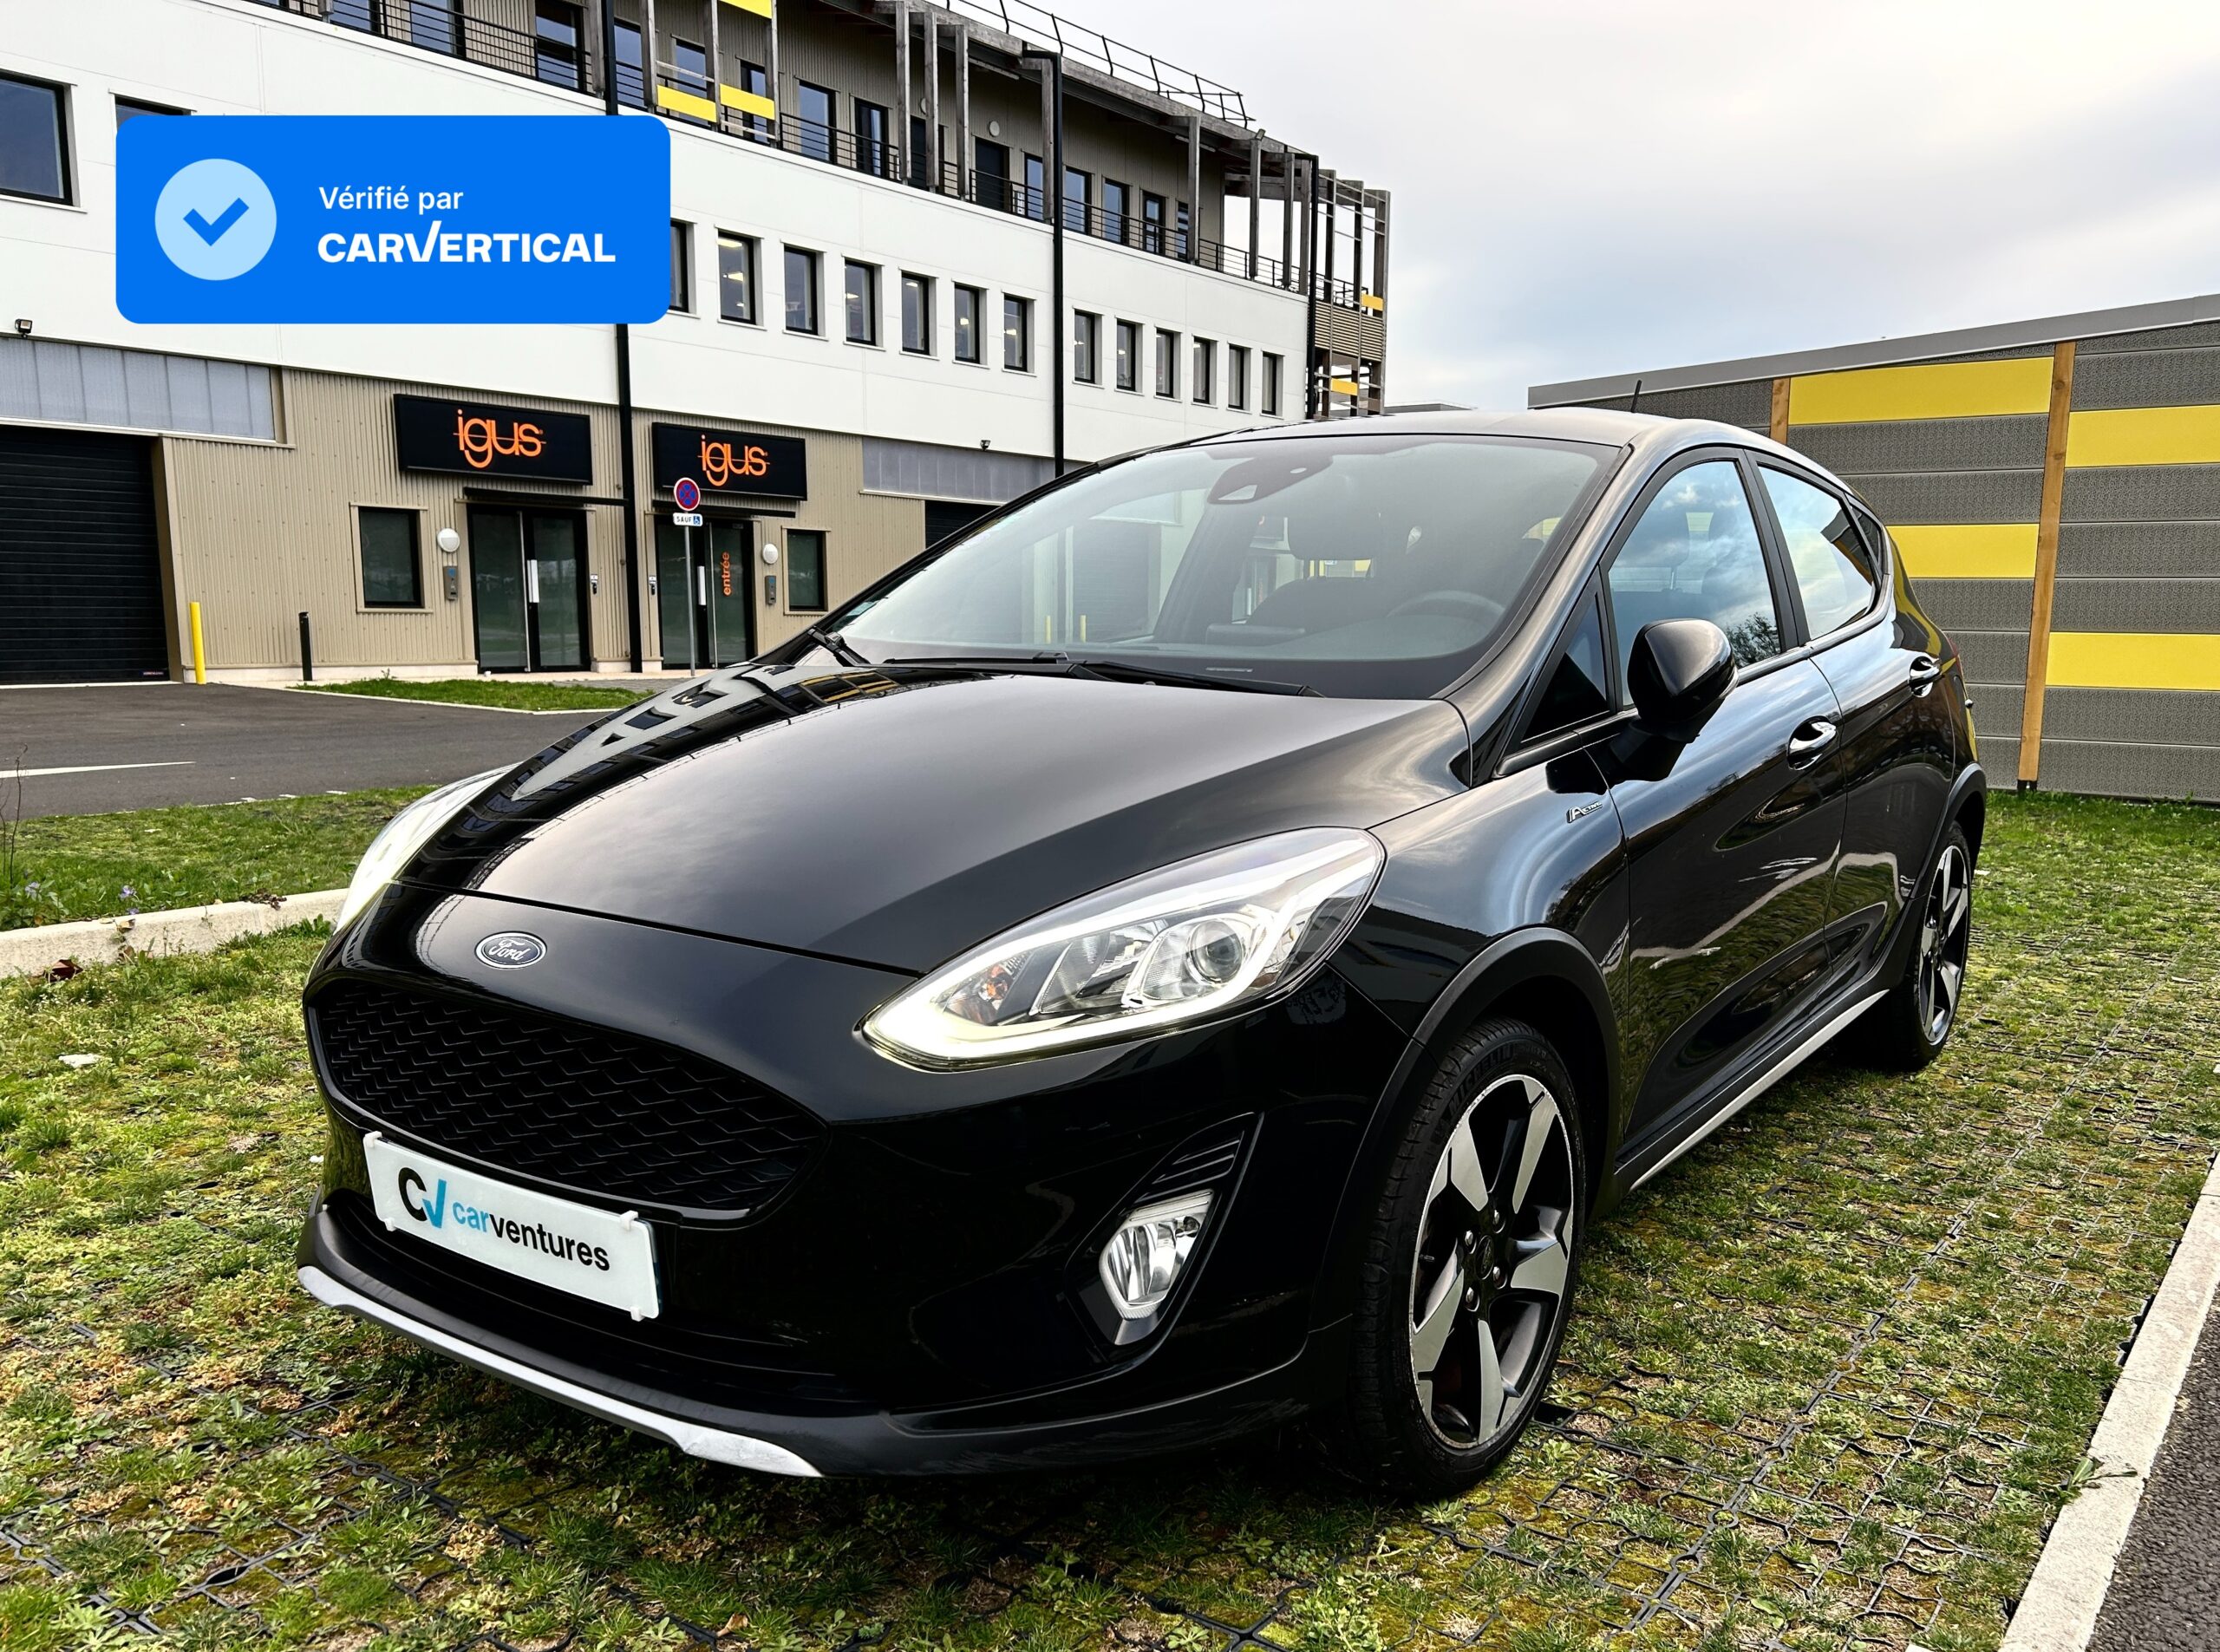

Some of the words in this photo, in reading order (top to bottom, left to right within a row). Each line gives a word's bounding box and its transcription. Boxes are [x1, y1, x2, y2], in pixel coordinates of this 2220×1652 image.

[456, 408, 544, 468] igus
[701, 434, 769, 487] igus
[720, 552, 732, 596] entrée
[488, 939, 531, 961] Ford
[451, 1200, 611, 1272] carventures
